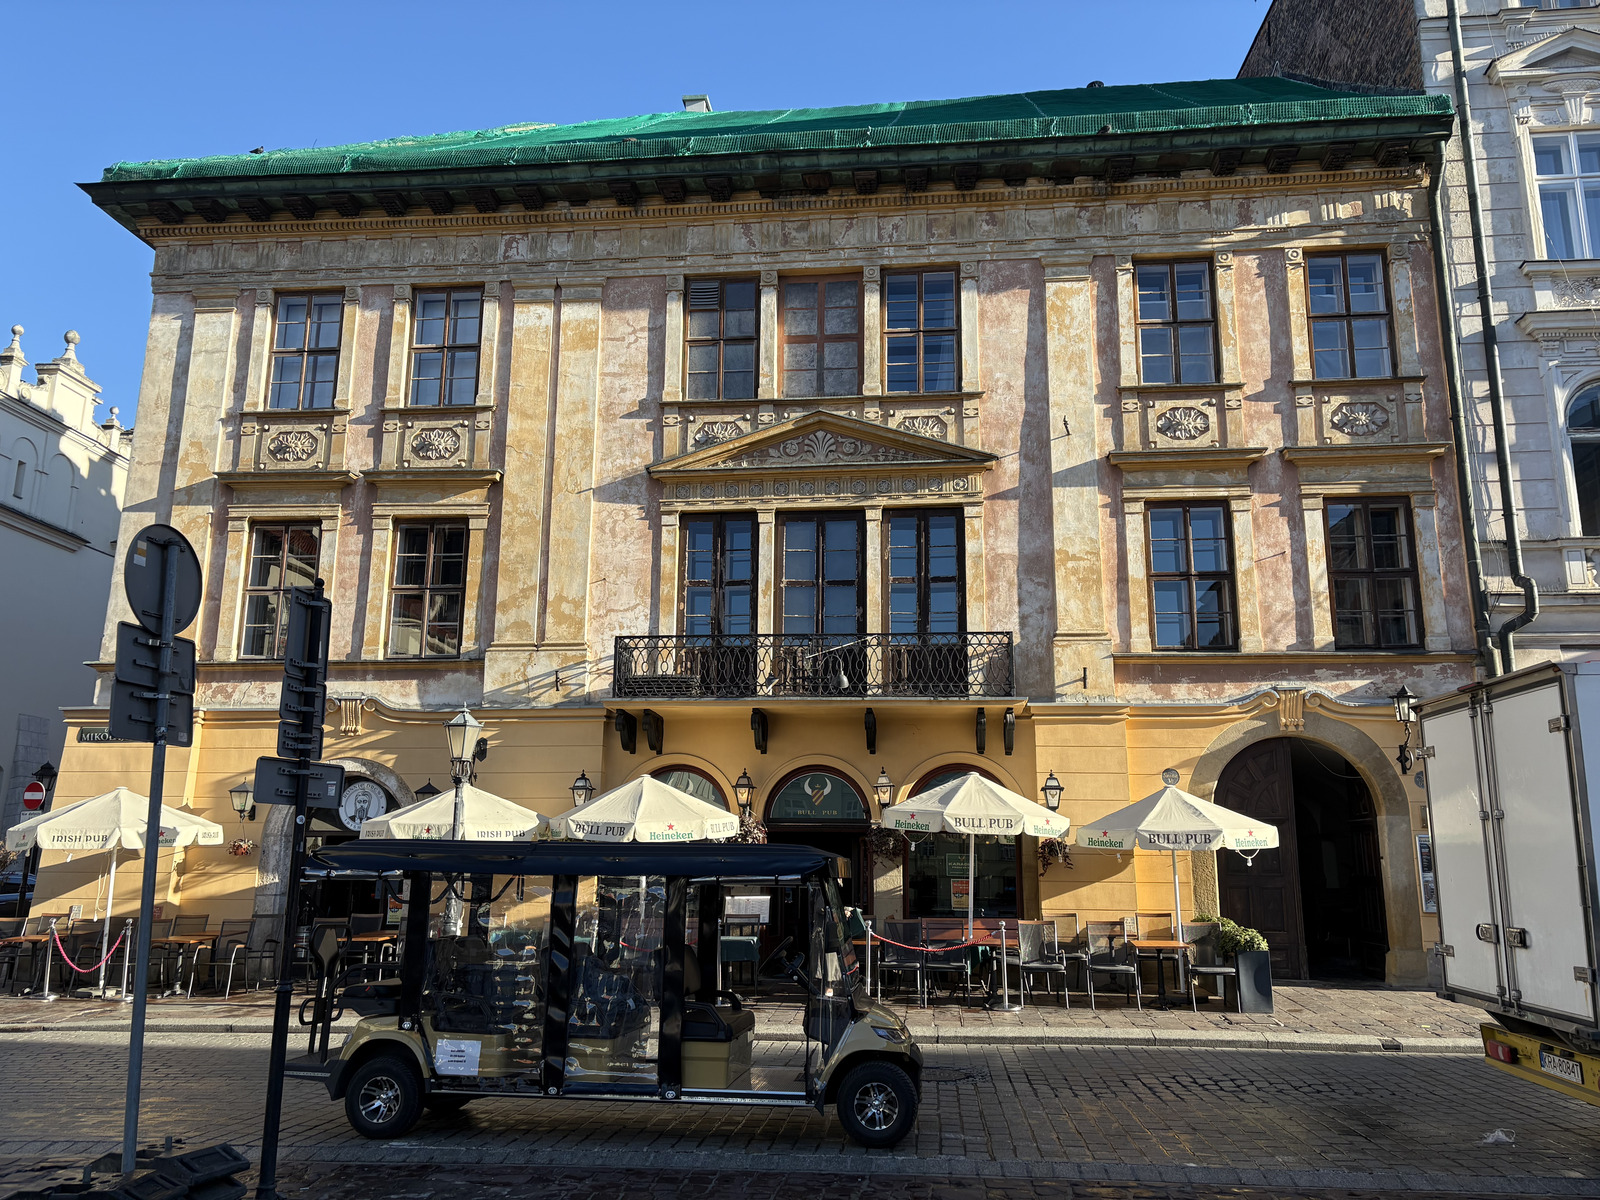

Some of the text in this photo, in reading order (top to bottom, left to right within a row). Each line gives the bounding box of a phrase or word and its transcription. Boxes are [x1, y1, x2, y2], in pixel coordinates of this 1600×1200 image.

[722, 821, 735, 831] PUB
[895, 819, 931, 831] Heineken
[954, 817, 1014, 829] BULL PUB
[477, 830, 526, 838] IRISH PUB
[574, 823, 602, 835] BULL
[605, 826, 626, 836] PUB
[1033, 825, 1062, 837] Heineken
[649, 830, 694, 841] Heineken
[1148, 833, 1212, 844] BULL PUB
[1087, 837, 1124, 848] Heineken
[1235, 838, 1268, 848] Heineken
